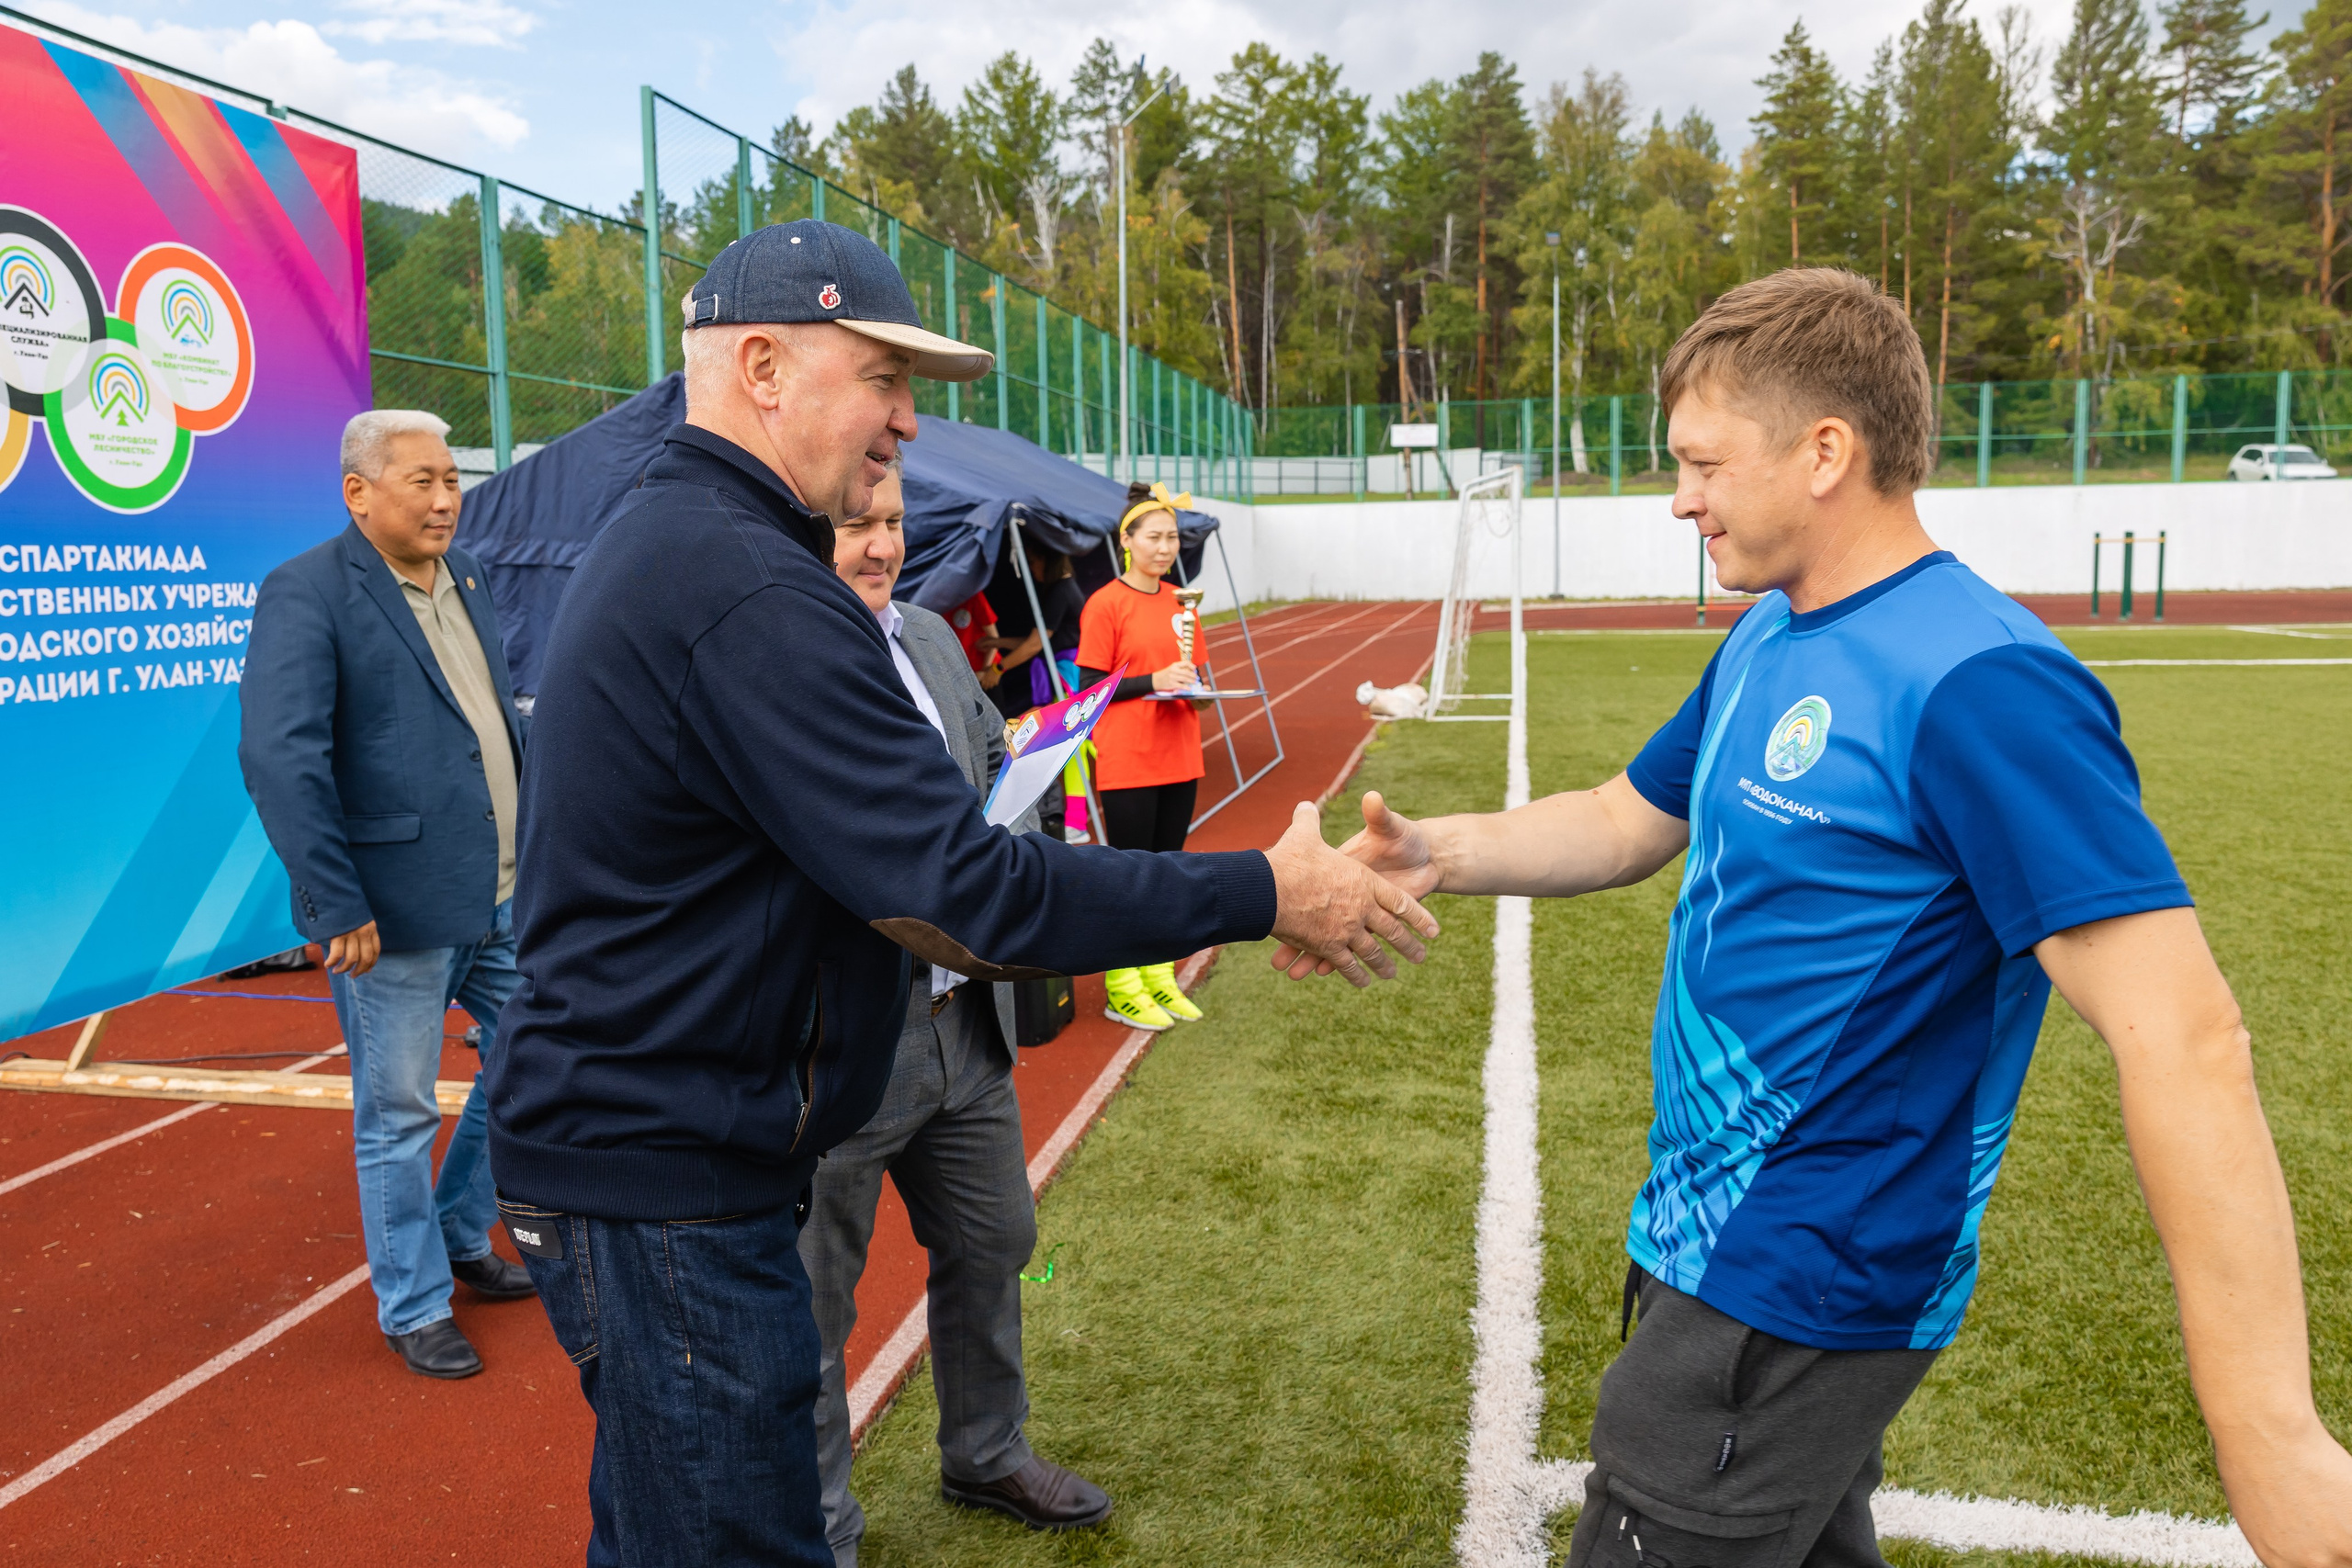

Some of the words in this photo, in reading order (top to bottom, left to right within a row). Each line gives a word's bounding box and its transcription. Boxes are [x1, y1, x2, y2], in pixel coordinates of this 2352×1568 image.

[0, 544, 208, 573] СПАРТАКИАДА
[0, 585, 158, 617] СТВЕННЫХ
[162, 581, 261, 609] УЧРЕЖД
[0, 626, 138, 662] ОДСКОГО
[0, 669, 100, 705] РАЦИИ
[107, 667, 130, 694] Г.
